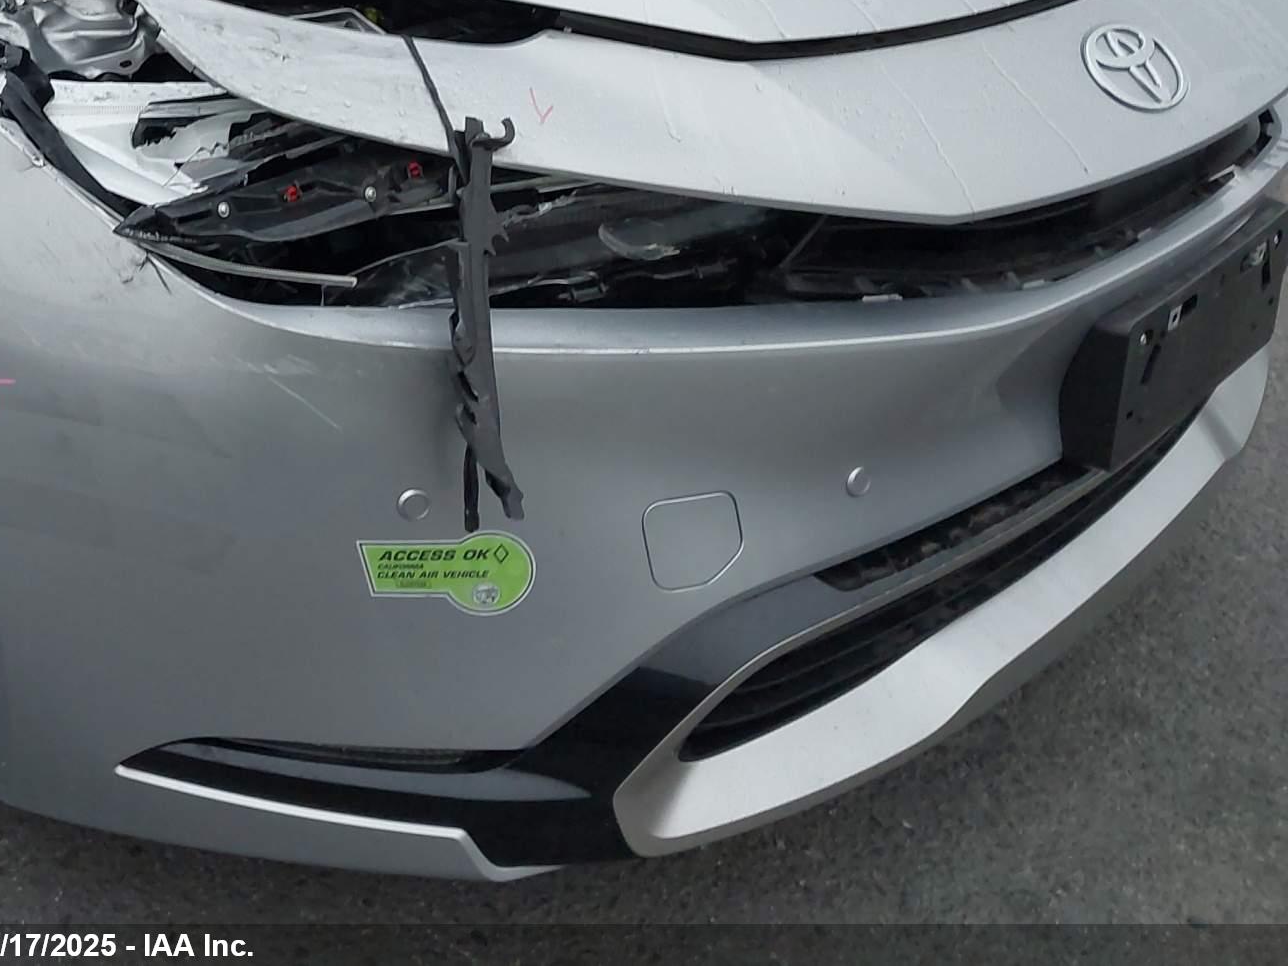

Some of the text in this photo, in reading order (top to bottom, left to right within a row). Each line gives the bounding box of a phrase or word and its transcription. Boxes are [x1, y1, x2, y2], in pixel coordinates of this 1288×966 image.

[378, 548, 490, 562] ACCESS OK
[377, 570, 490, 579] CLEAN AIR VEHICLE
